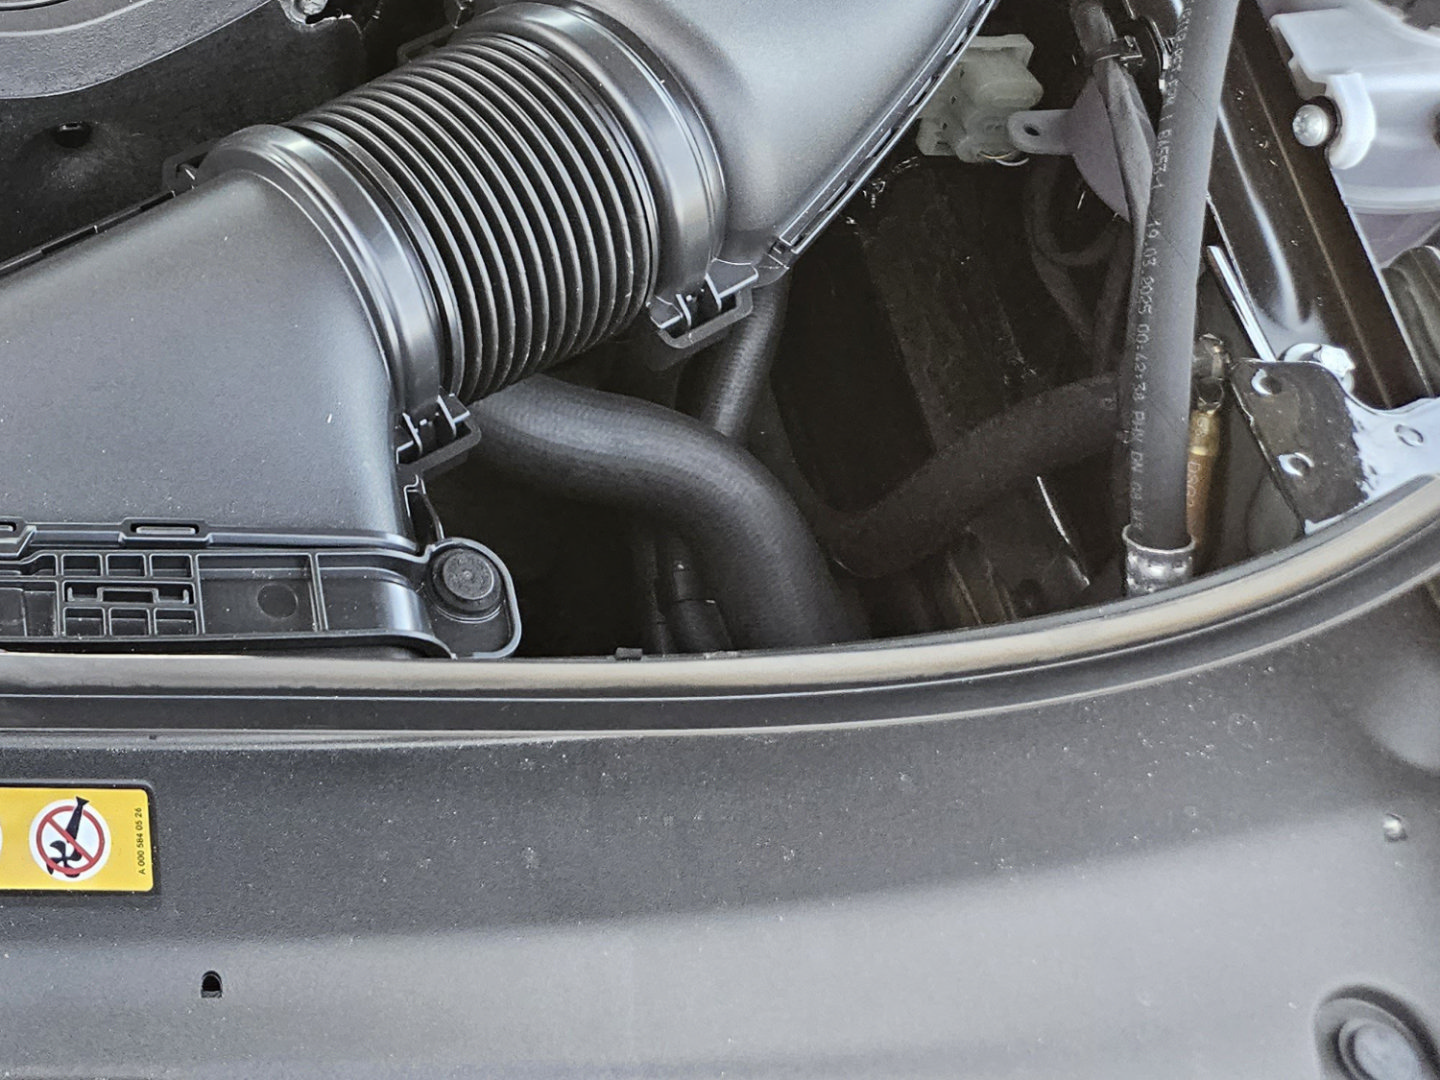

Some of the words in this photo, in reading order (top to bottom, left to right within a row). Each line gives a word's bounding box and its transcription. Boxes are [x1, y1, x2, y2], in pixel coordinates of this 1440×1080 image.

[135, 820, 143, 831] 05
[136, 833, 144, 848] 584
[137, 850, 145, 866] 000
